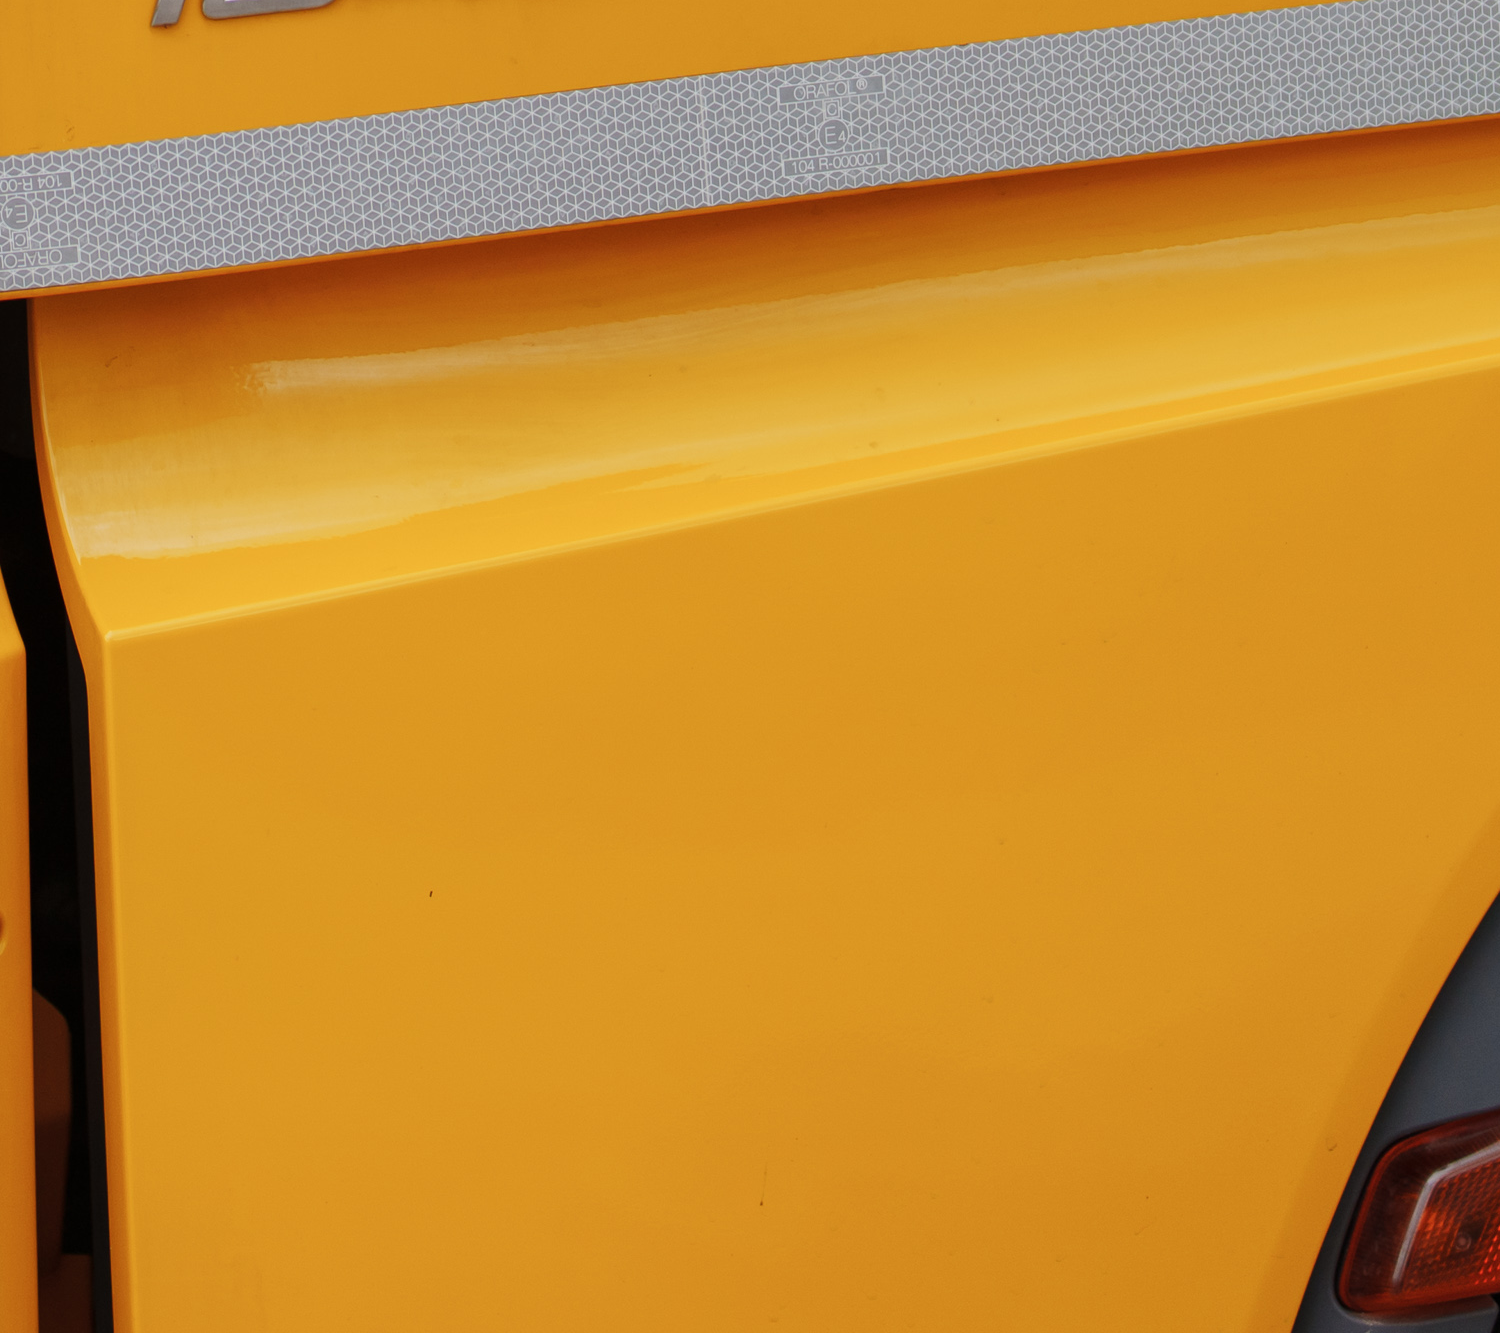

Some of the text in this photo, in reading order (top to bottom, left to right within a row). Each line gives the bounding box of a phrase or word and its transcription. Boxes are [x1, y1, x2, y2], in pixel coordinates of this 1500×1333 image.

[793, 81, 857, 101] ORAFOL
[824, 126, 846, 144] E4
[792, 159, 815, 174] 104
[37, 174, 62, 190] 104
